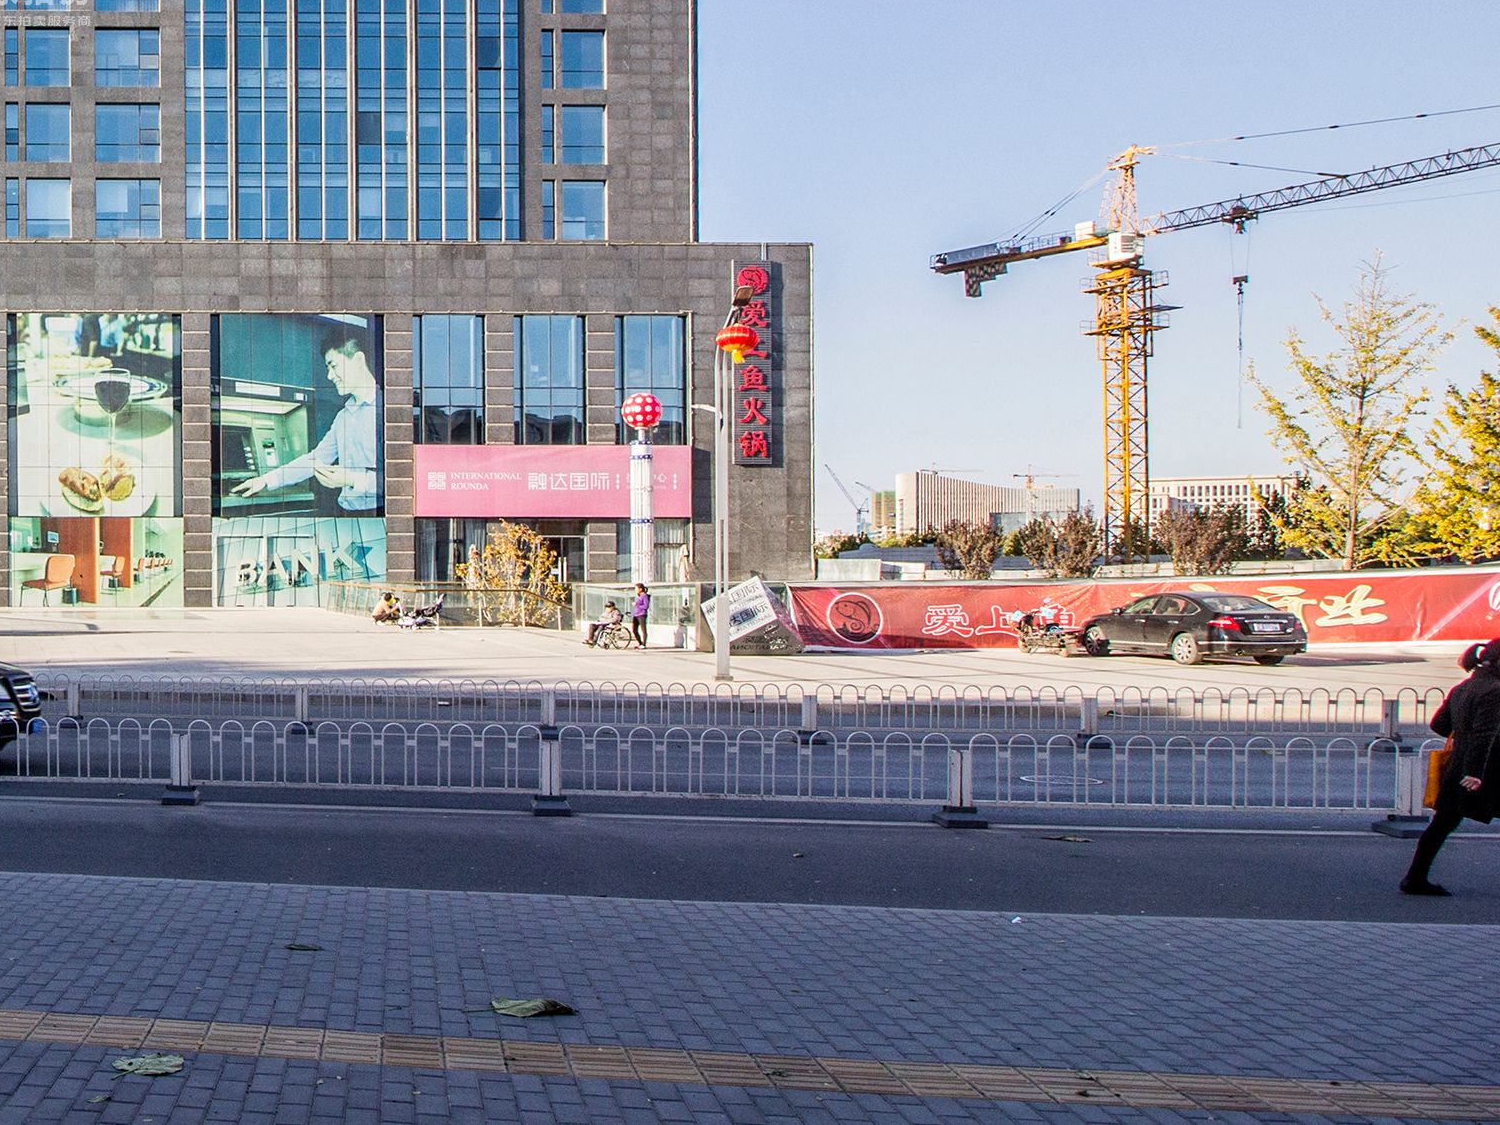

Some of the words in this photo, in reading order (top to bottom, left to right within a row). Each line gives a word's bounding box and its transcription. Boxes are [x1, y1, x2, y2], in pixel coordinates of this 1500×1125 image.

[450, 472, 522, 481] INTERNATIONAL
[527, 472, 611, 491] 融达国际
[450, 482, 490, 491] ROUNDA
[236, 541, 365, 588] BANK
